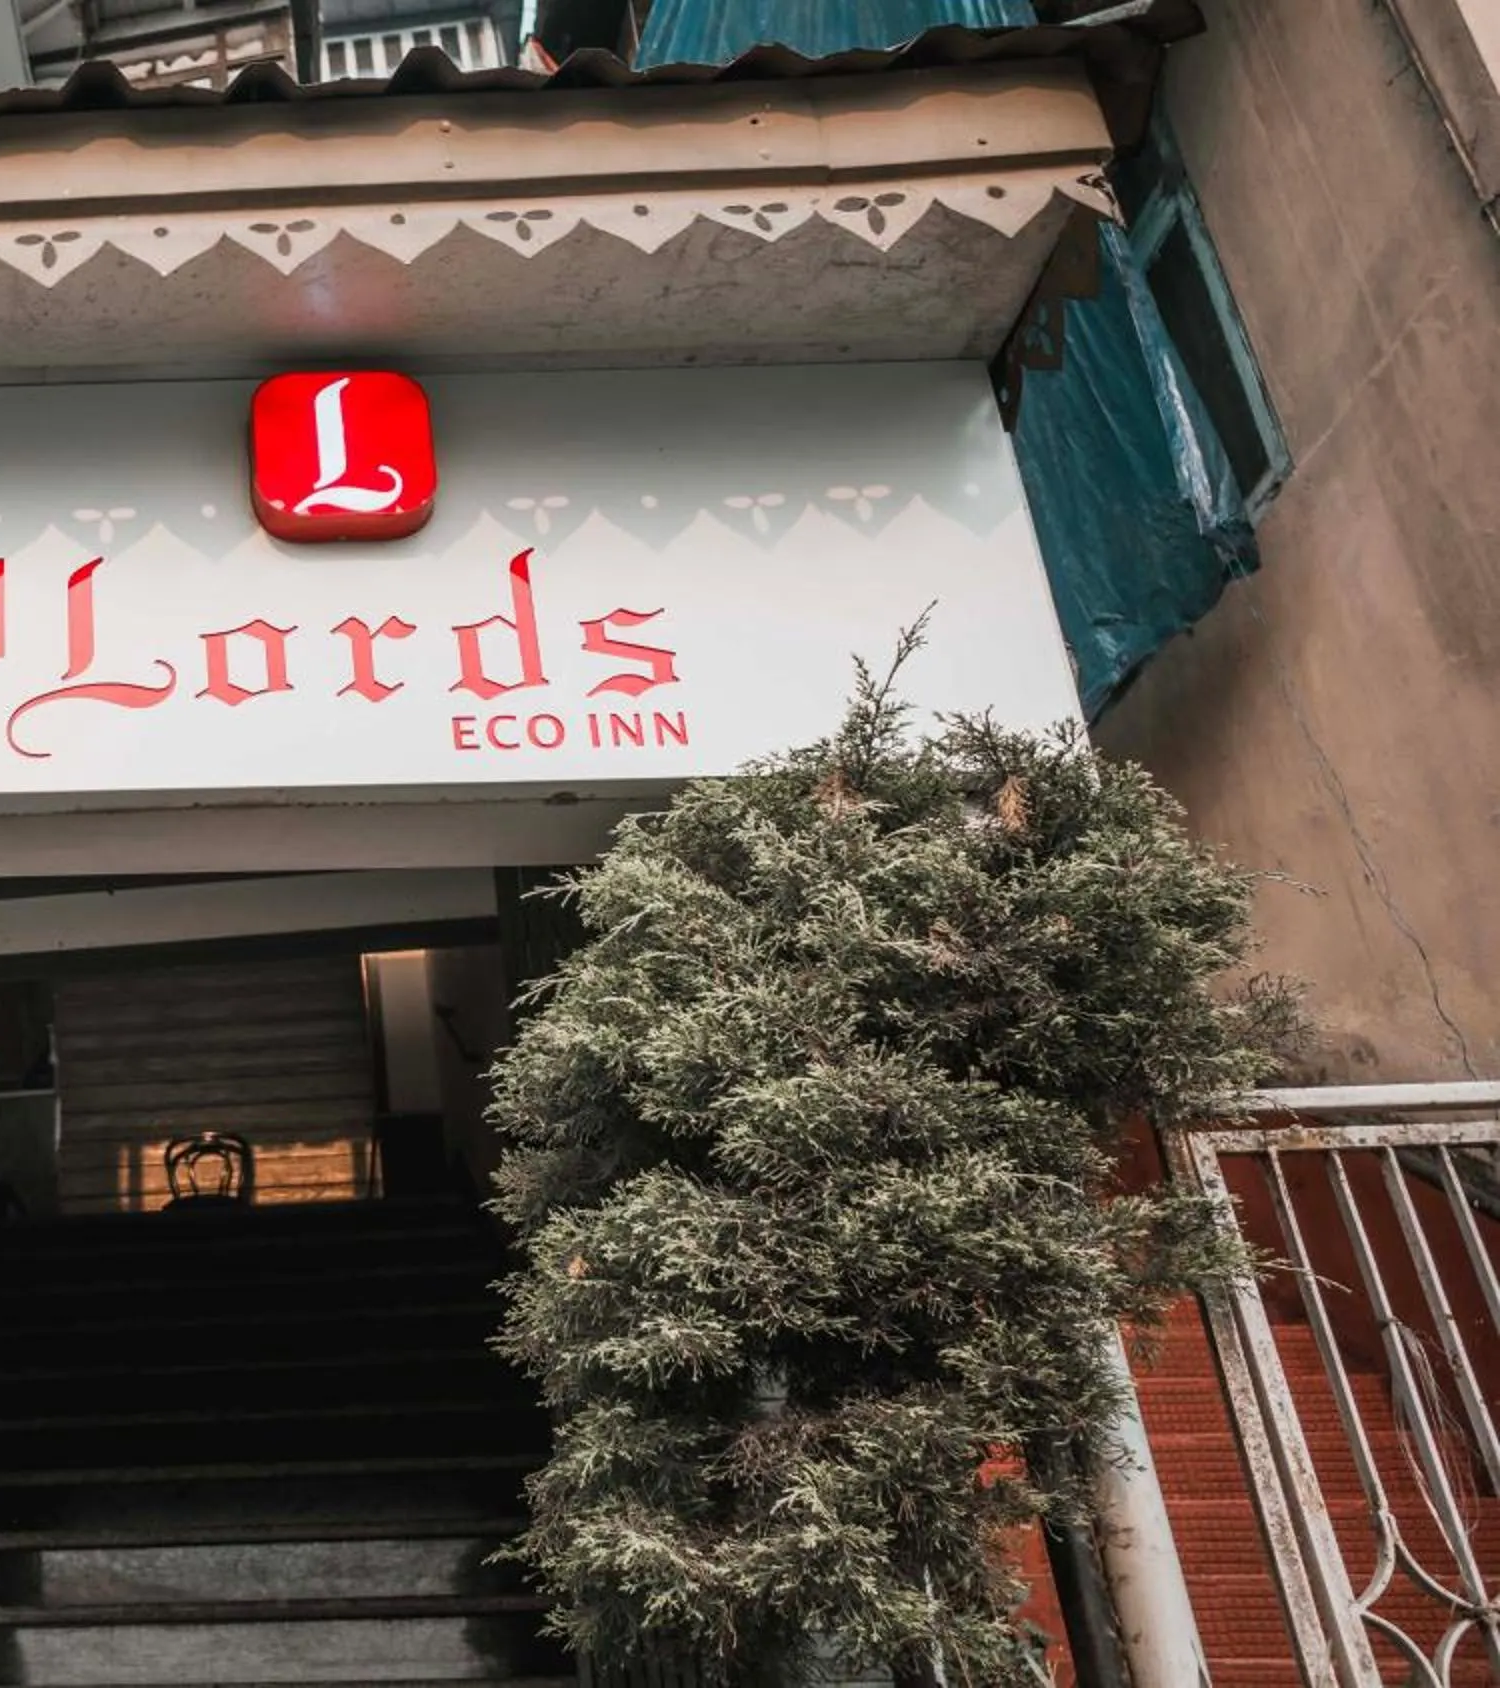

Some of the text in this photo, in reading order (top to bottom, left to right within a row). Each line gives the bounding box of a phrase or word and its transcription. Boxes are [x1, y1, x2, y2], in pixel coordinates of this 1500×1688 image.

[292, 376, 404, 513] L
[5, 547, 681, 758] Lords
[451, 711, 690, 752] ECO INN
